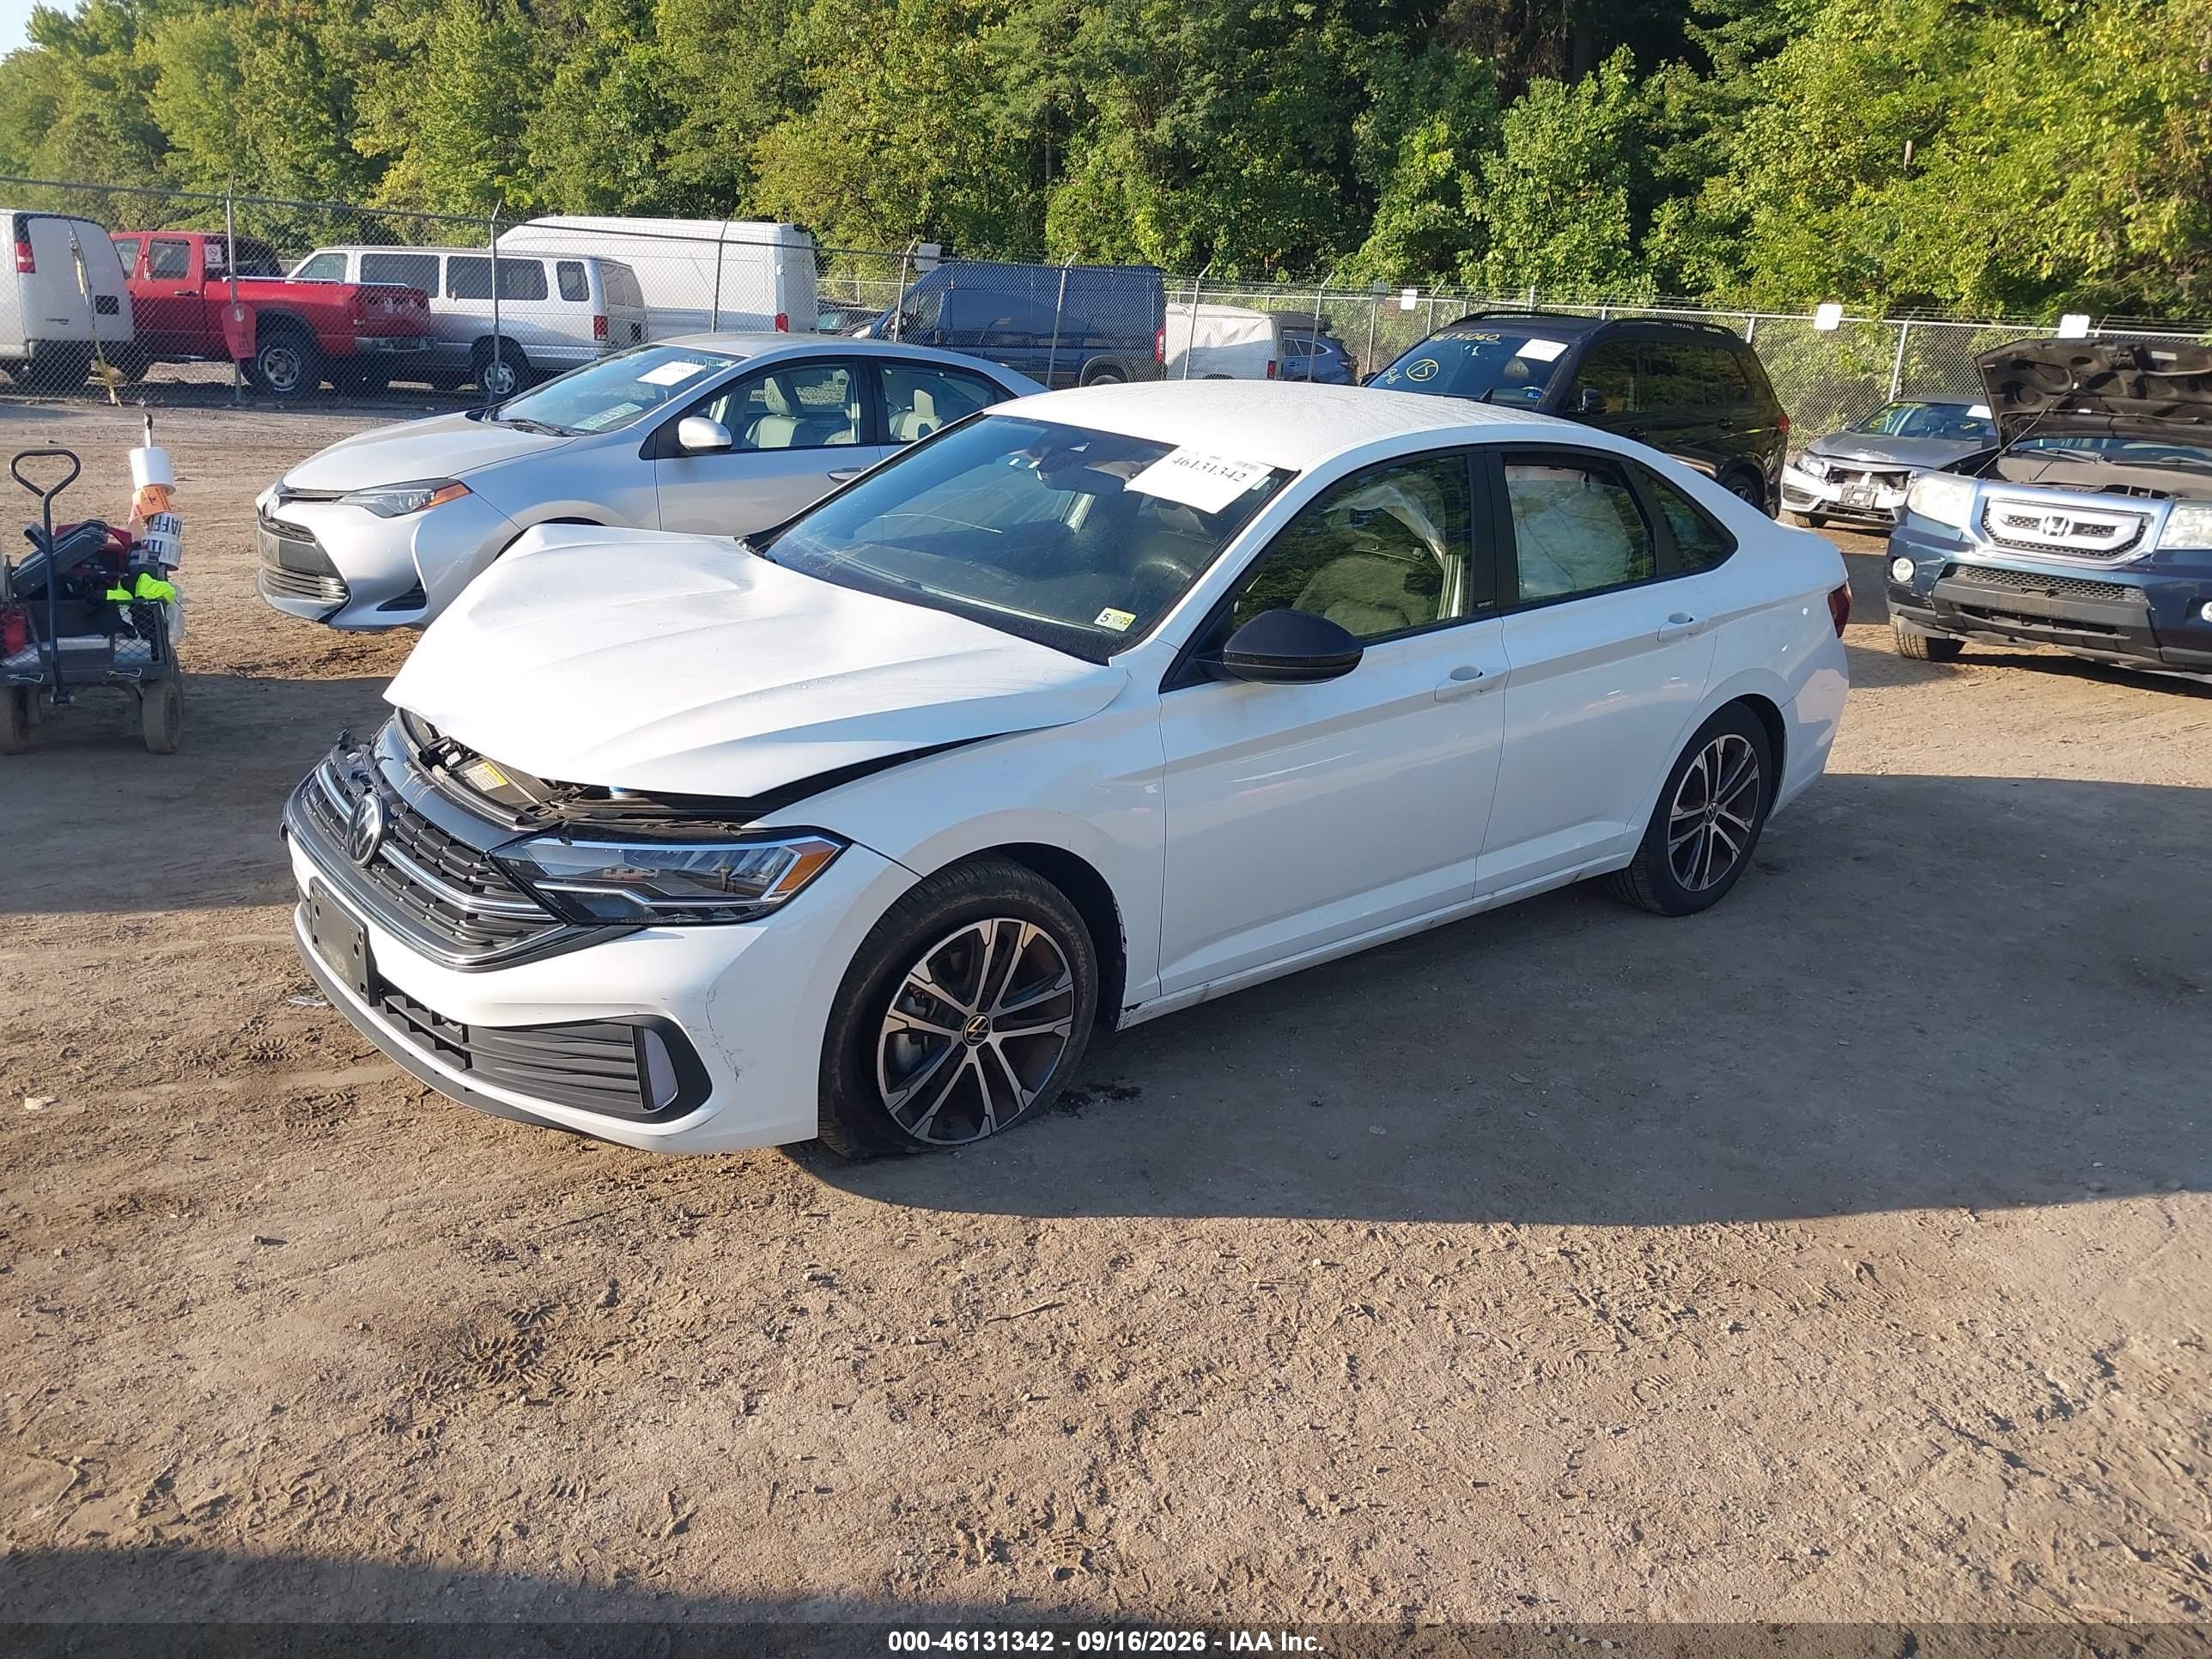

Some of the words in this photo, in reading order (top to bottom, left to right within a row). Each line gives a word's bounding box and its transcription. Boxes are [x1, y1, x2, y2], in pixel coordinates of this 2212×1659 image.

[1171, 456, 1248, 483] 46131342
[1100, 612, 1112, 623] 5
[1119, 617, 1133, 626] 25
